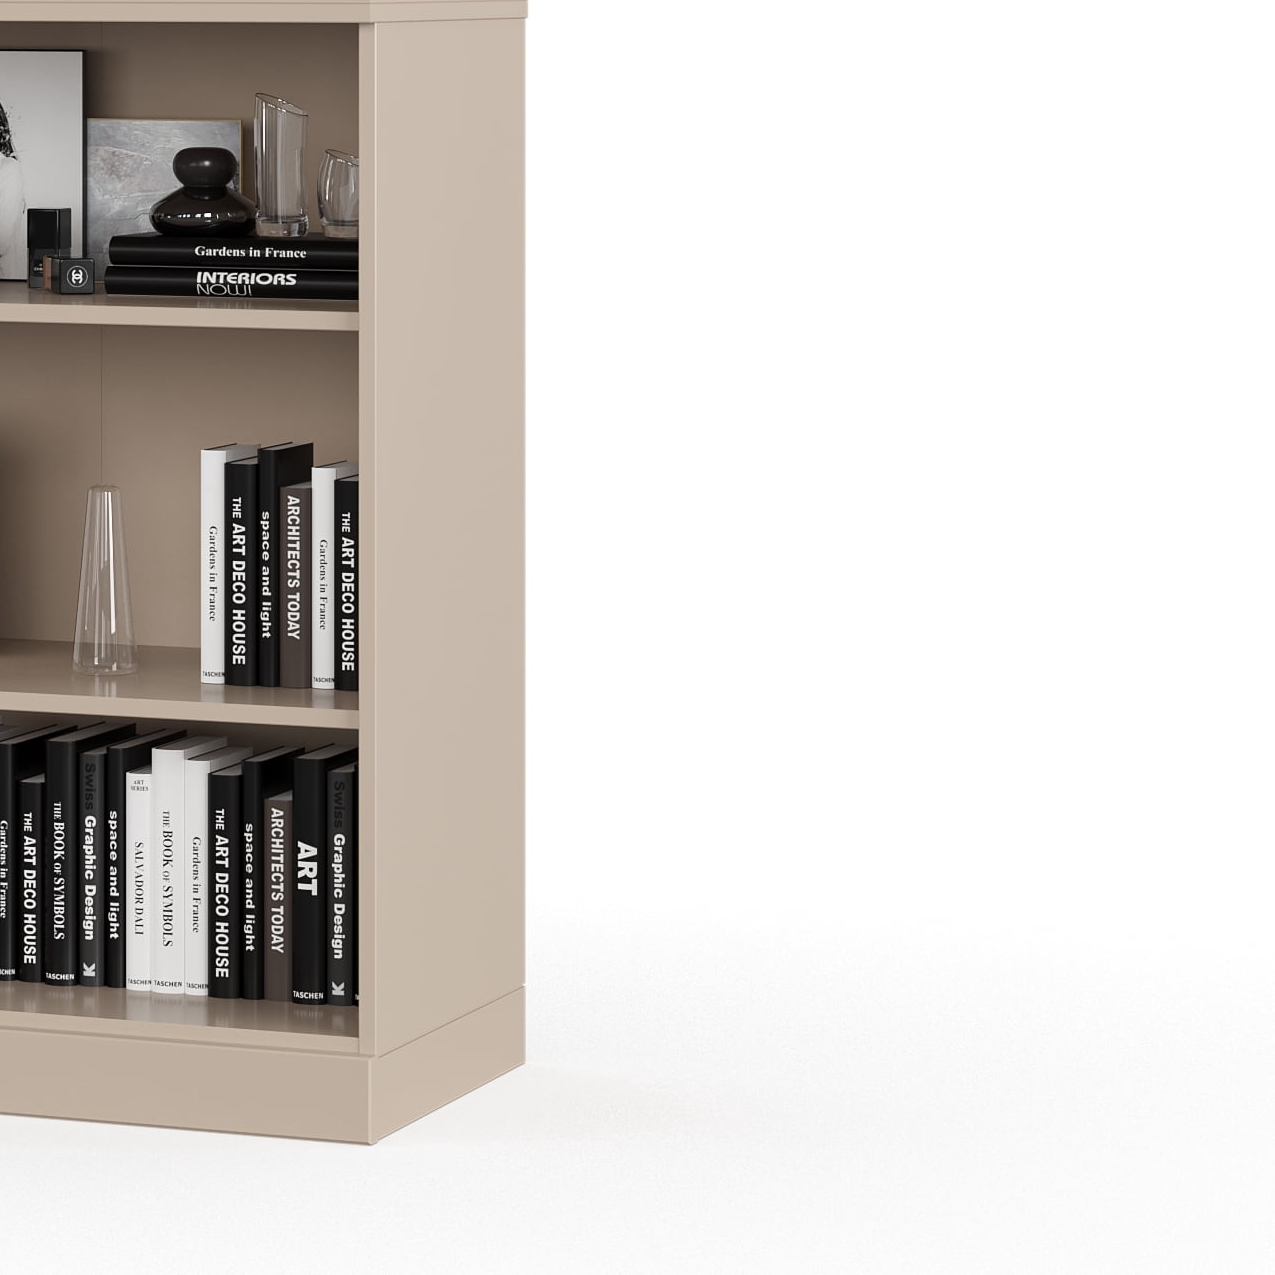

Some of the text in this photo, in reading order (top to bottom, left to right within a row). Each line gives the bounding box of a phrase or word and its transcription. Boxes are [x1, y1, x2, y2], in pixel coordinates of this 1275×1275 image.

[194, 245, 307, 259] Gardens in France
[196, 271, 297, 286] INTERIORS
[208, 525, 218, 622] Gardens in France
[232, 496, 247, 665] THE ART DECO HOUSE
[259, 511, 272, 639] space and light
[287, 495, 301, 640] ARCHITECTS TODAY
[341, 511, 355, 672] THE ART DECO HOUSE
[53, 801, 62, 820] THE
[53, 821, 66, 860] BOOK
[162, 810, 171, 829] THE
[82, 815, 97, 880] Graphic
[107, 810, 120, 940] space and light
[162, 830, 174, 868] BOOK
[297, 840, 318, 896] ART
[331, 833, 346, 899] Graphic
[23, 812, 37, 965] THE ART DECO HOUSE
[53, 877, 66, 940] SYMBOLS
[215, 808, 230, 978] THE ART DECO HOUSE
[243, 823, 256, 952] space and light
[270, 807, 285, 954] ARCHITECTS TODAY
[82, 884, 97, 941] Design
[162, 885, 174, 947] SYMBOLS
[331, 903, 346, 959] Design
[45, 972, 75, 981] TASCHEN
[154, 979, 183, 988] TASCHEN
[292, 990, 324, 1000] TASCHEN
